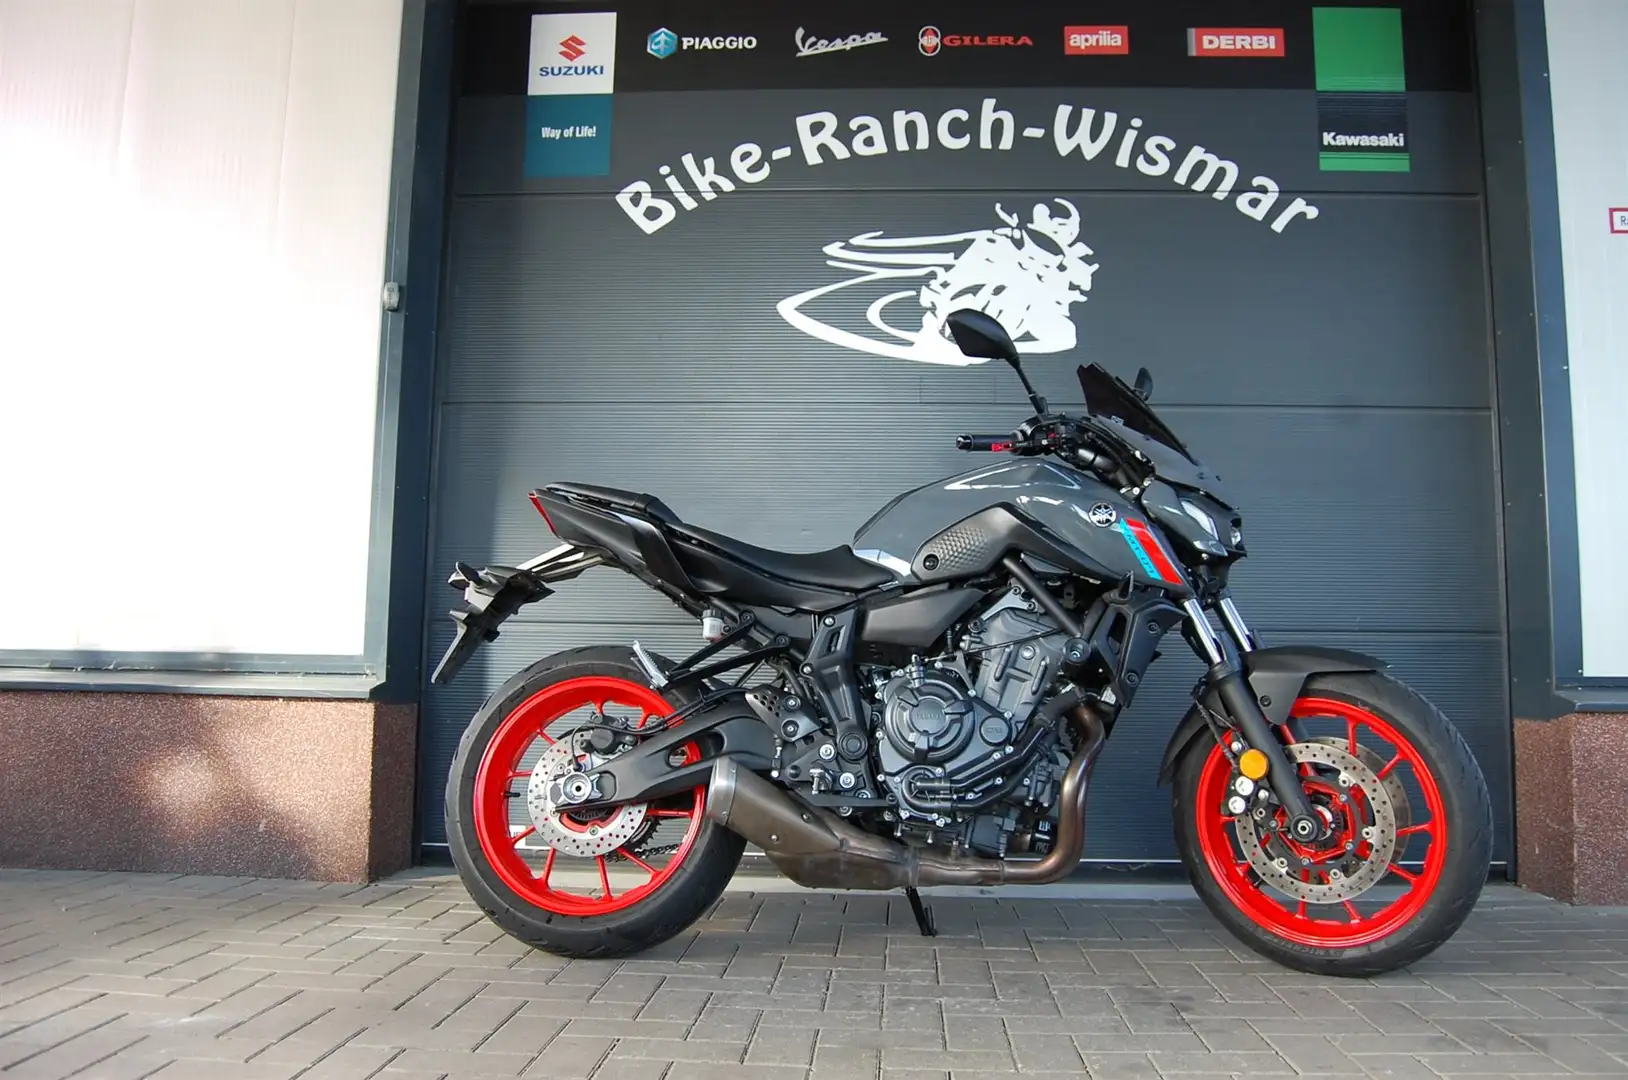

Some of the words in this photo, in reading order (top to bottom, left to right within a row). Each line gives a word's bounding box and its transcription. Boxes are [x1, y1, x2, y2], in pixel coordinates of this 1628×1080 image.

[682, 36, 757, 49] PIAGGIO
[795, 26, 888, 57] Vespa
[943, 34, 1033, 47] GILERA
[1069, 30, 1122, 49] aprilia
[1202, 35, 1276, 49] DERBI
[539, 65, 604, 77] SUZUKI
[541, 127, 561, 140] Way
[563, 126, 575, 138] of
[575, 125, 597, 138] Life!
[1322, 131, 1405, 147] Kawasaki
